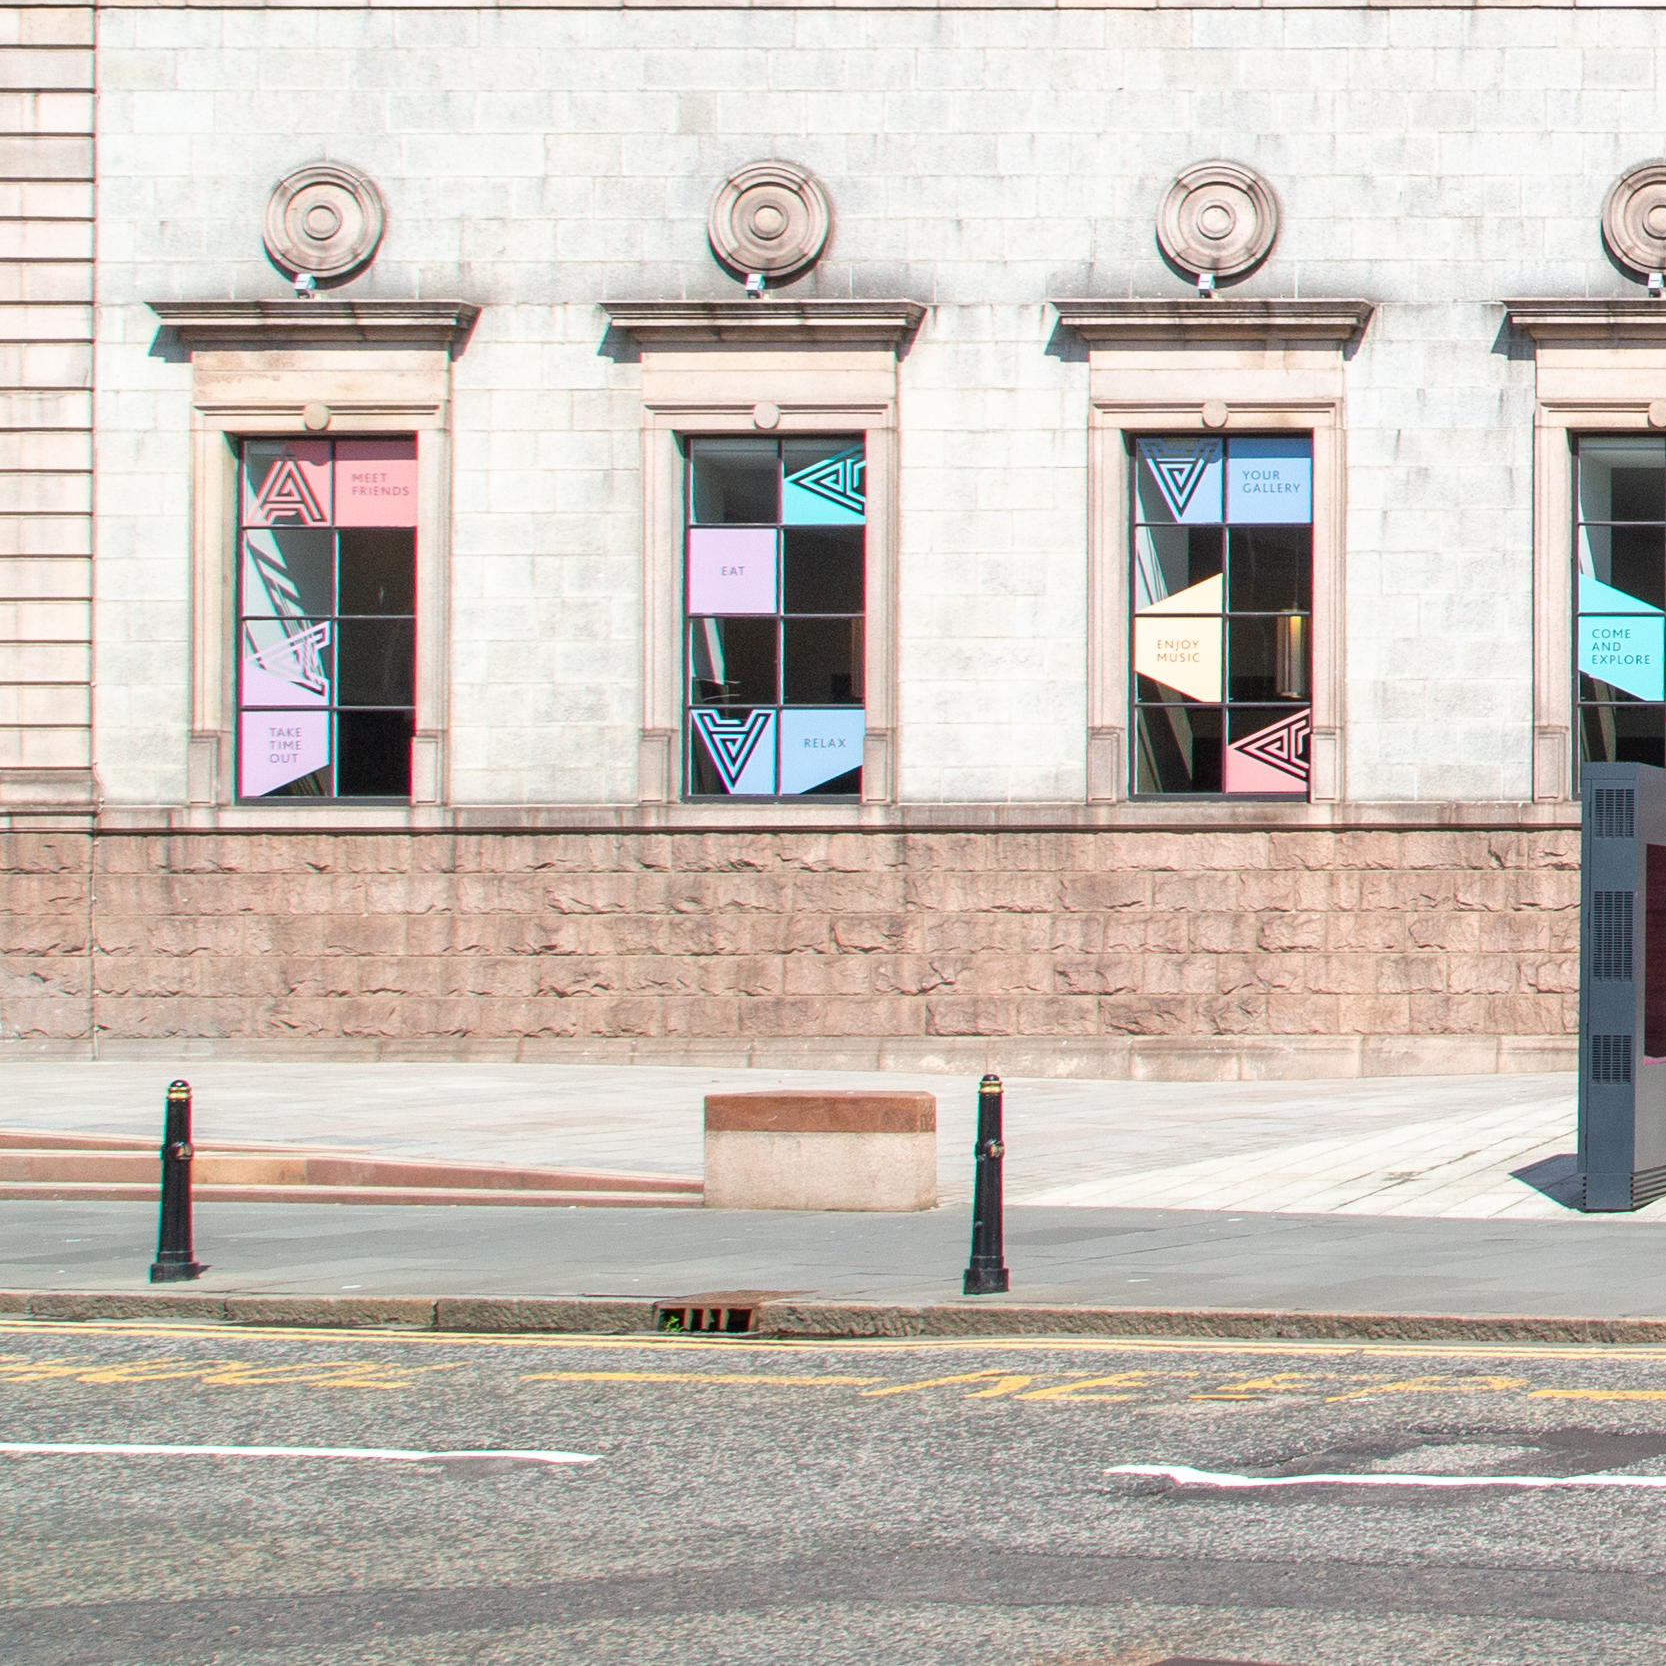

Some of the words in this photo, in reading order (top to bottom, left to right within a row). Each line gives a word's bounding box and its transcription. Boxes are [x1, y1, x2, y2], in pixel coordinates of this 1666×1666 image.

[351, 472, 387, 484] MEET
[1242, 470, 1281, 481] YOUR
[351, 485, 410, 497] FRIENDS
[1242, 482, 1301, 494] GALLERY
[721, 565, 746, 577] EAT
[1591, 628, 1631, 639] COME
[1157, 639, 1200, 652] ENJOY
[1591, 641, 1622, 652] AND
[1156, 652, 1200, 663] MUSIC
[1591, 654, 1651, 665] EXPLORE
[269, 727, 302, 738] TAKE
[269, 740, 302, 751] TIME
[804, 737, 847, 749] RELAX
[269, 753, 299, 764] OUT
[0, 1354, 473, 1389] HOOL
[859, 1368, 1532, 1403] KEEP
